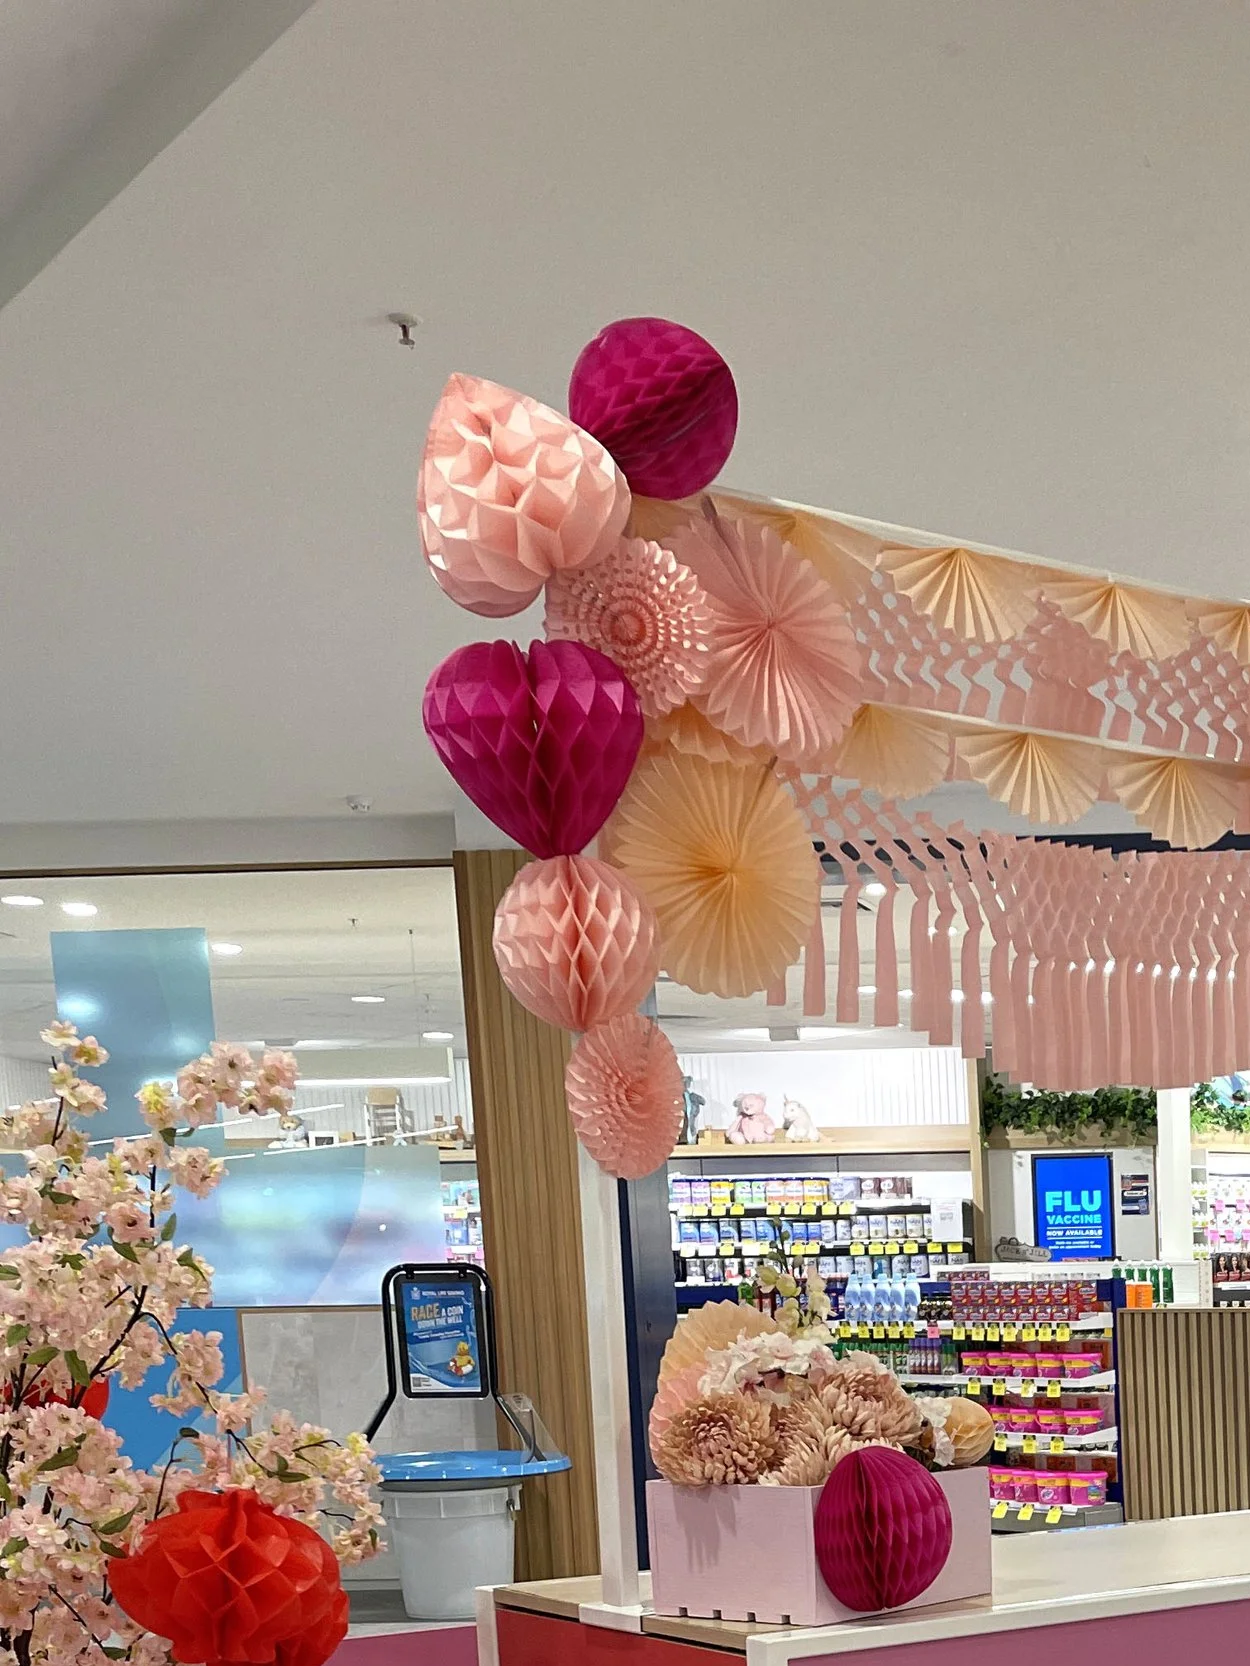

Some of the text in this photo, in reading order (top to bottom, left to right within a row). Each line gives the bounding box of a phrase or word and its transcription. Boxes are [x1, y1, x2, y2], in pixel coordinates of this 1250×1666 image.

[1045, 1190, 1102, 1213] FLU
[1046, 1214, 1102, 1225] VACCINE
[411, 1303, 440, 1321] RACE
[441, 1308, 447, 1317] A
